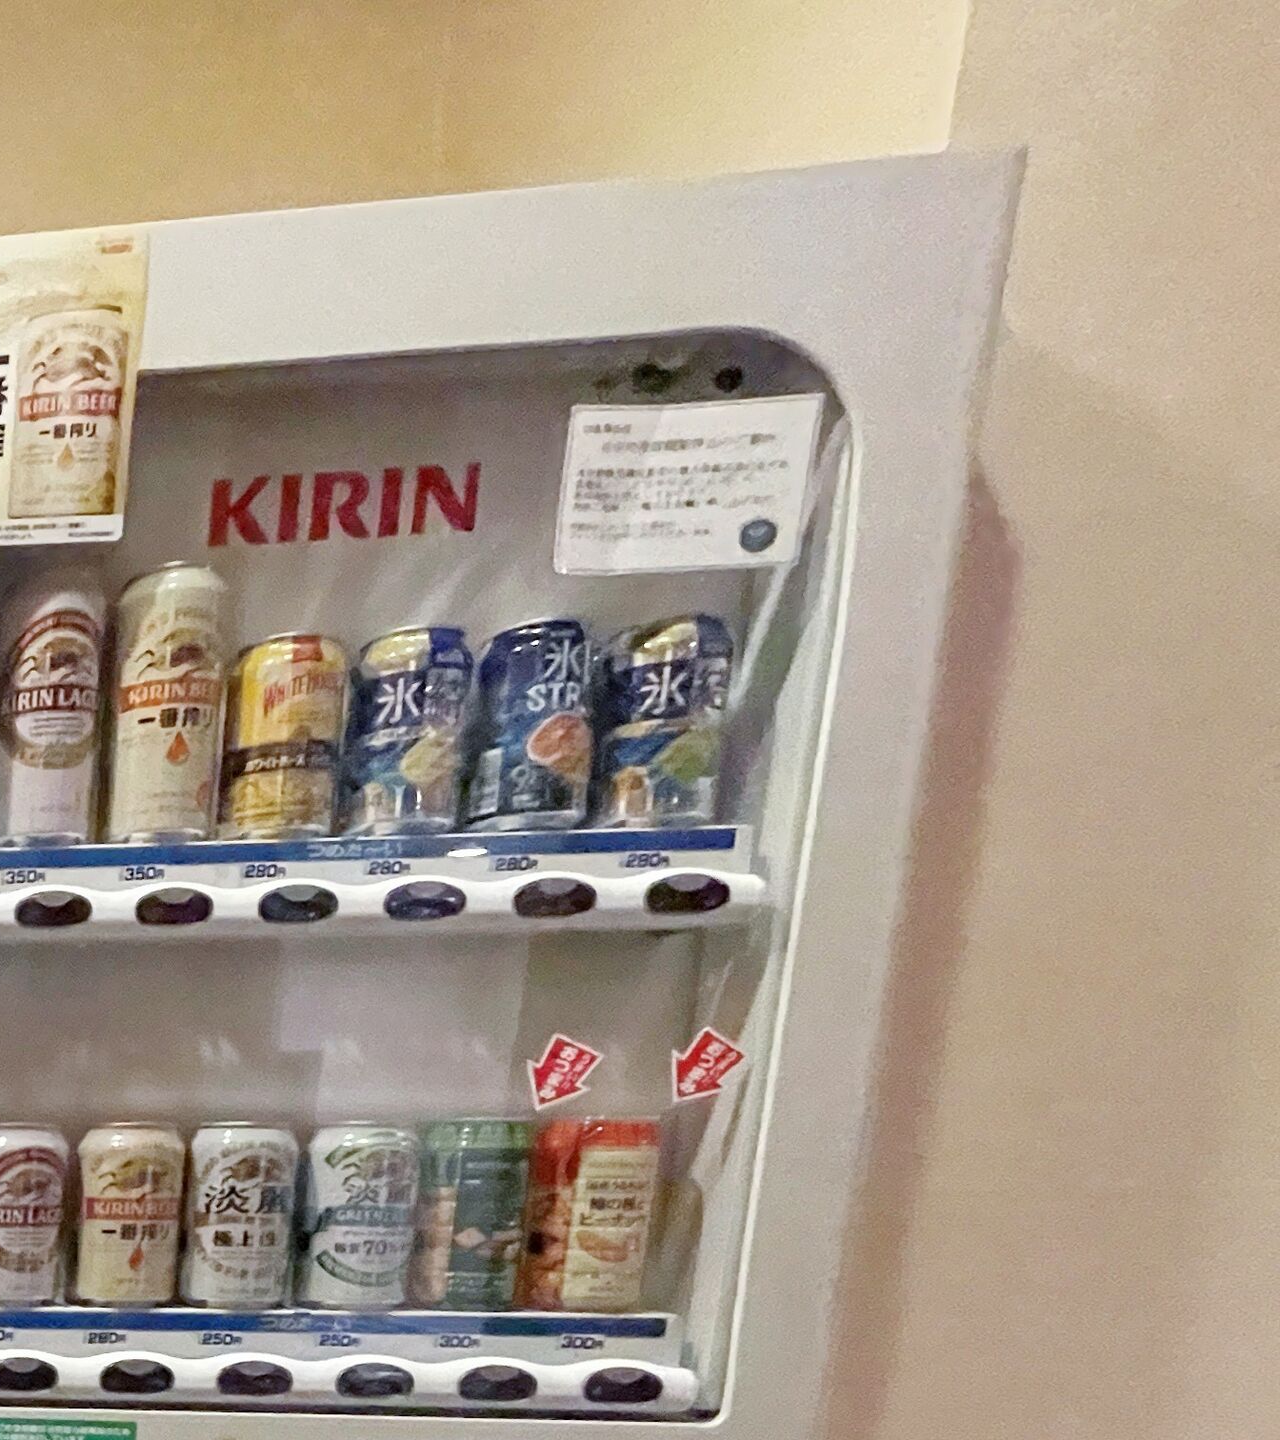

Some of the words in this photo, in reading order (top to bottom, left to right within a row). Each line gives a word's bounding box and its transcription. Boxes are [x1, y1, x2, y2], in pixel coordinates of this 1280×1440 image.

[23, 392, 70, 419] KIRIN
[39, 422, 98, 439] 一番搾り
[207, 461, 482, 548] KIRIN
[128, 682, 185, 705] KIRIN
[93, 1200, 141, 1215] KIRIN
